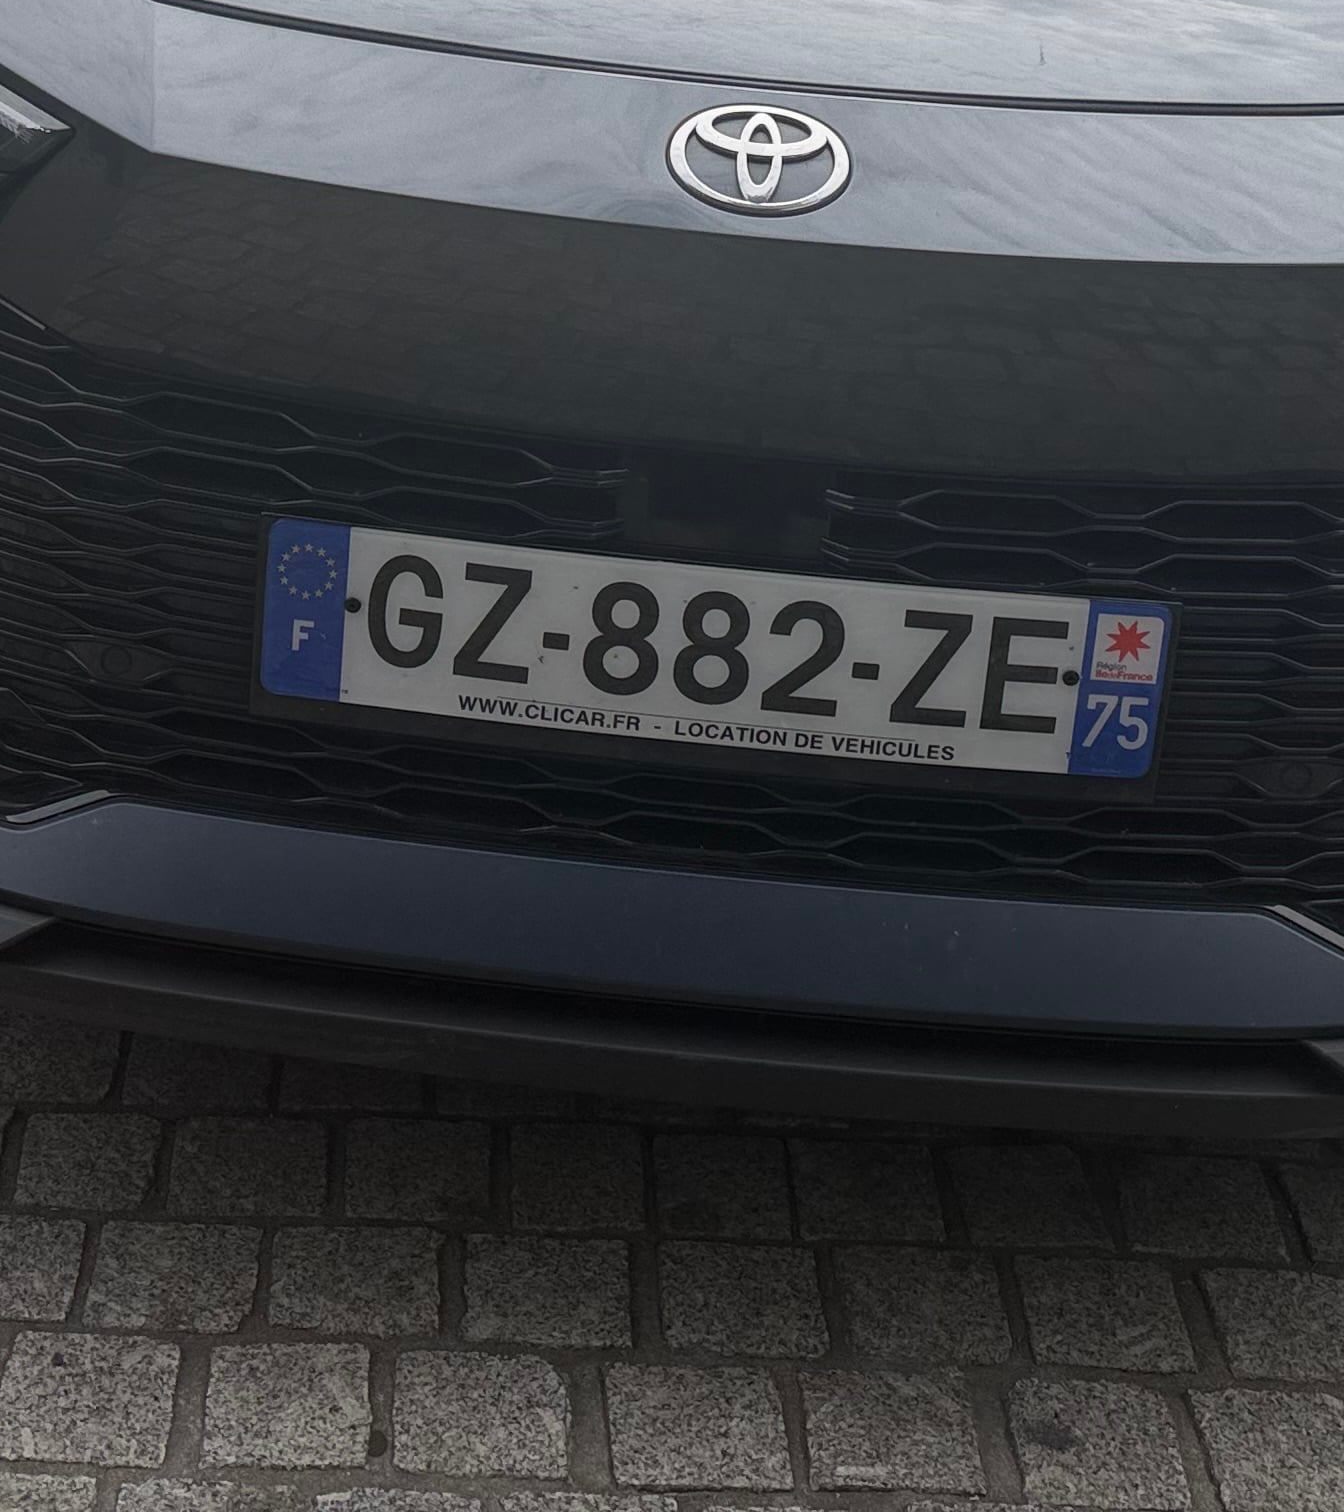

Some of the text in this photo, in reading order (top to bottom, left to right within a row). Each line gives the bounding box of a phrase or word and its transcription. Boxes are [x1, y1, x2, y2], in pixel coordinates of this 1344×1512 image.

[291, 618, 316, 652] F
[366, 552, 1071, 736] GZ-882-ZE
[457, 694, 641, 732] WWW.CLICAR.FR
[674, 720, 788, 748] LOCATION
[794, 732, 824, 751] DE
[831, 735, 956, 761] VEHICULES
[1081, 693, 1150, 751] 75
